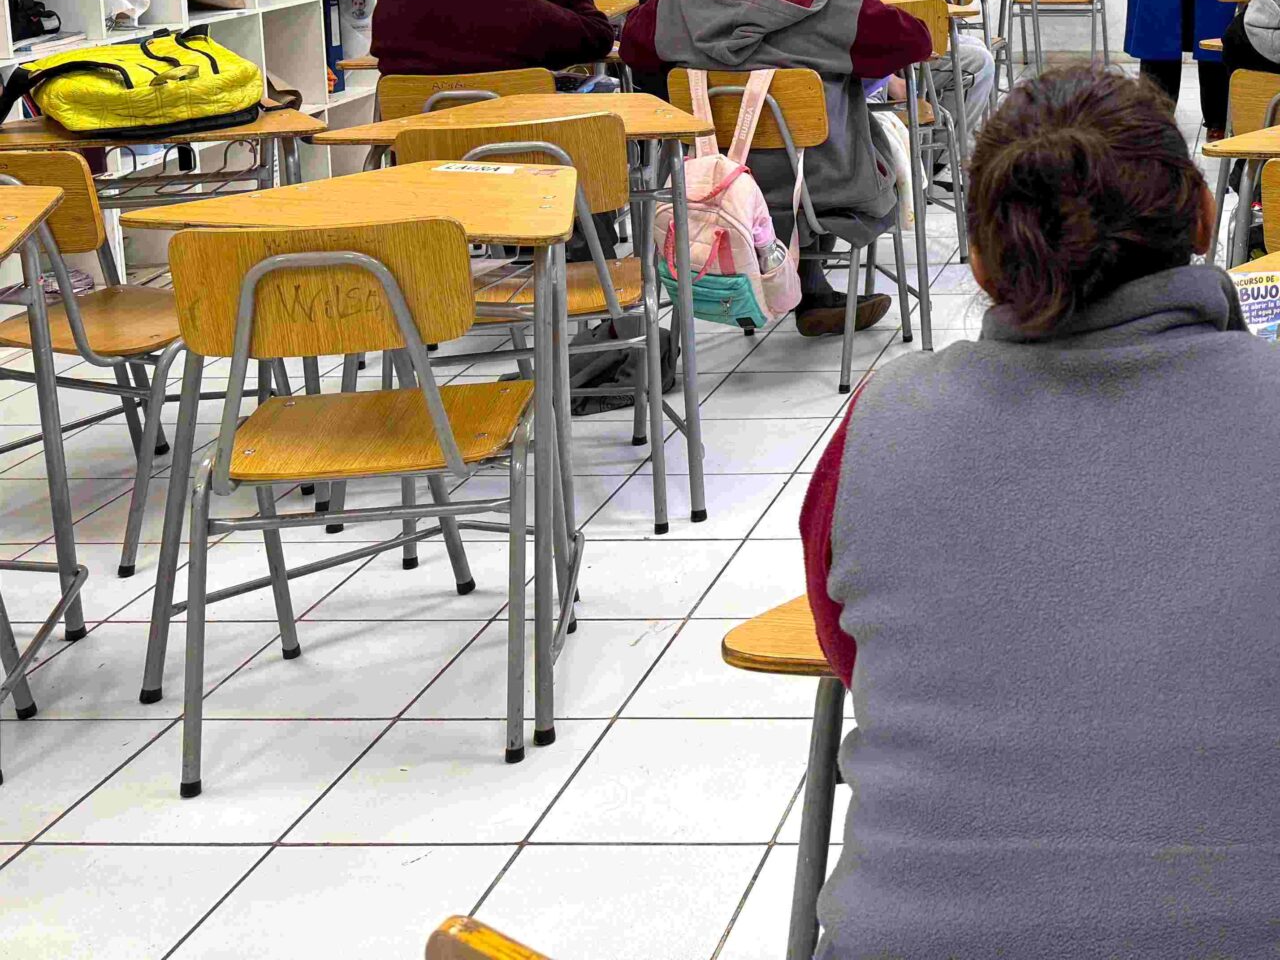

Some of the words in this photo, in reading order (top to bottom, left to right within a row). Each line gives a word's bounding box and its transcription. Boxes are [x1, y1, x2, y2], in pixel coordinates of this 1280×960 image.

[739, 106, 755, 140] BUBBA
[1233, 276, 1264, 287] NCURSO
[1265, 275, 1275, 283] DE
[1240, 284, 1280, 302] BUJO
